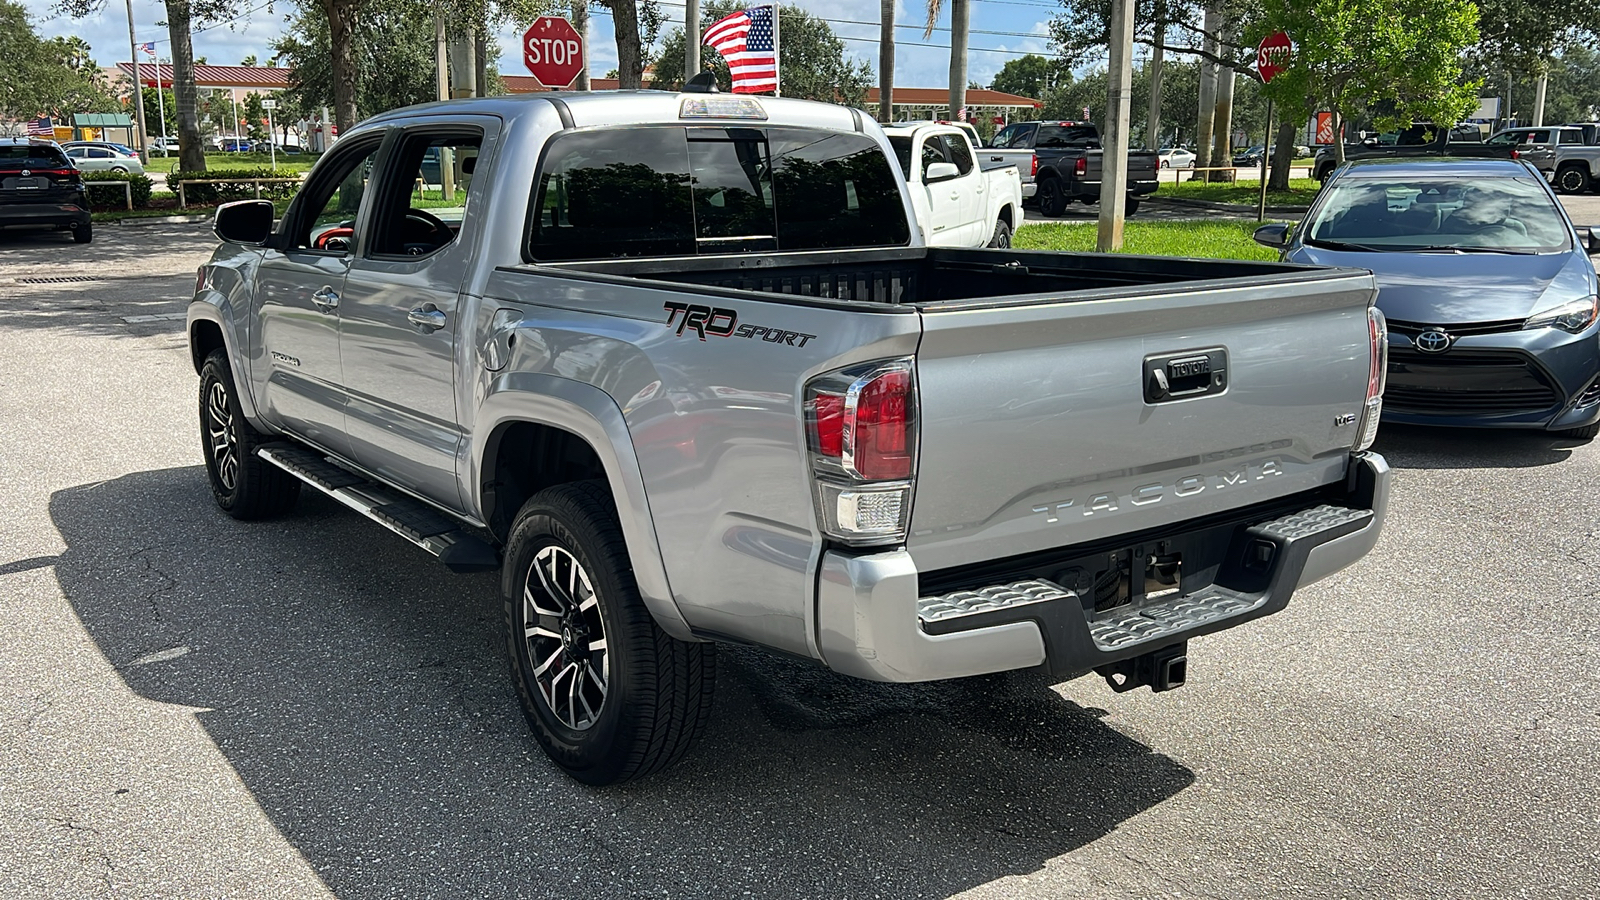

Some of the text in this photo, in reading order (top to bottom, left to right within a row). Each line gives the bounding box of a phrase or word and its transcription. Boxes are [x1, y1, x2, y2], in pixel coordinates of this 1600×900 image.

[528, 37, 579, 66] STOP
[663, 301, 817, 348] TRD SPORT
[1173, 360, 1210, 377] TOYOTA
[1032, 459, 1283, 522] TACOMA
